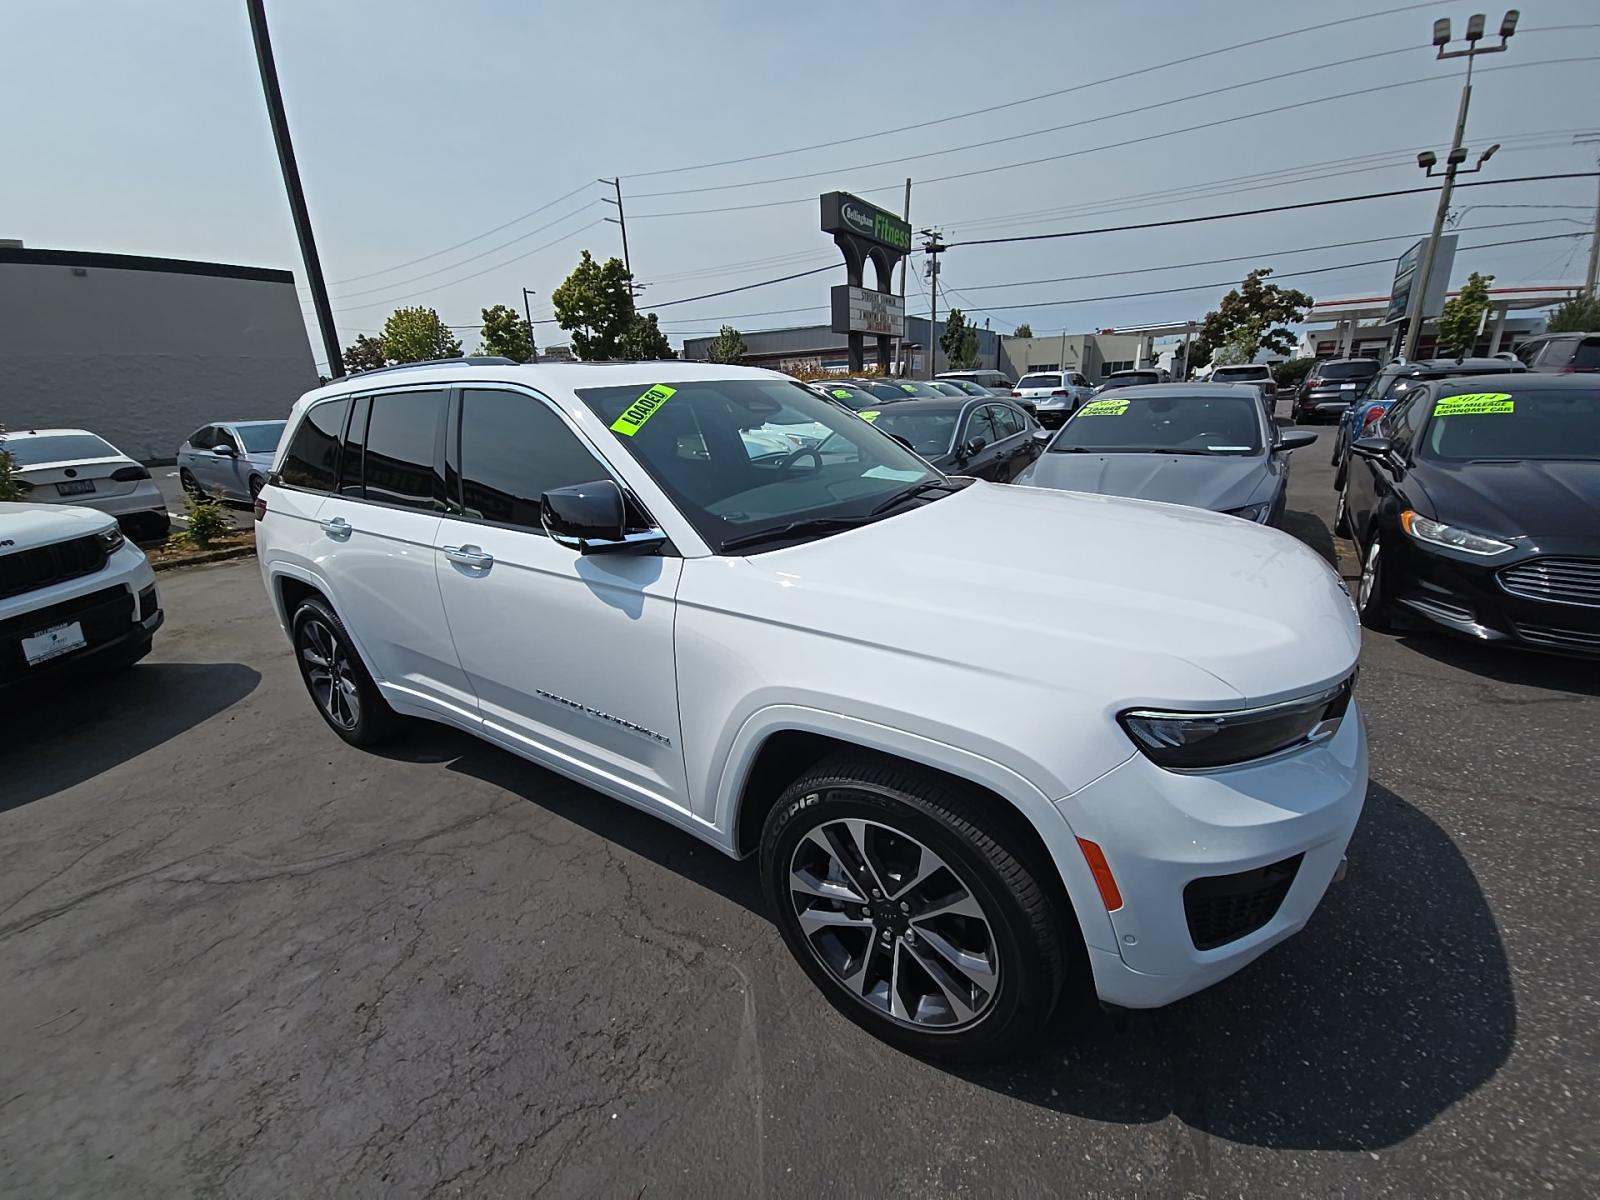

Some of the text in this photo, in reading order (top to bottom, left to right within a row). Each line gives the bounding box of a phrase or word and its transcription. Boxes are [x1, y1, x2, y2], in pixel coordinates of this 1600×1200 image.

[874, 213, 910, 250] Fitness
[621, 389, 666, 426] LOADED
[1436, 407, 1488, 415] ECONOMY
[1463, 400, 1506, 408] MILEAGE
